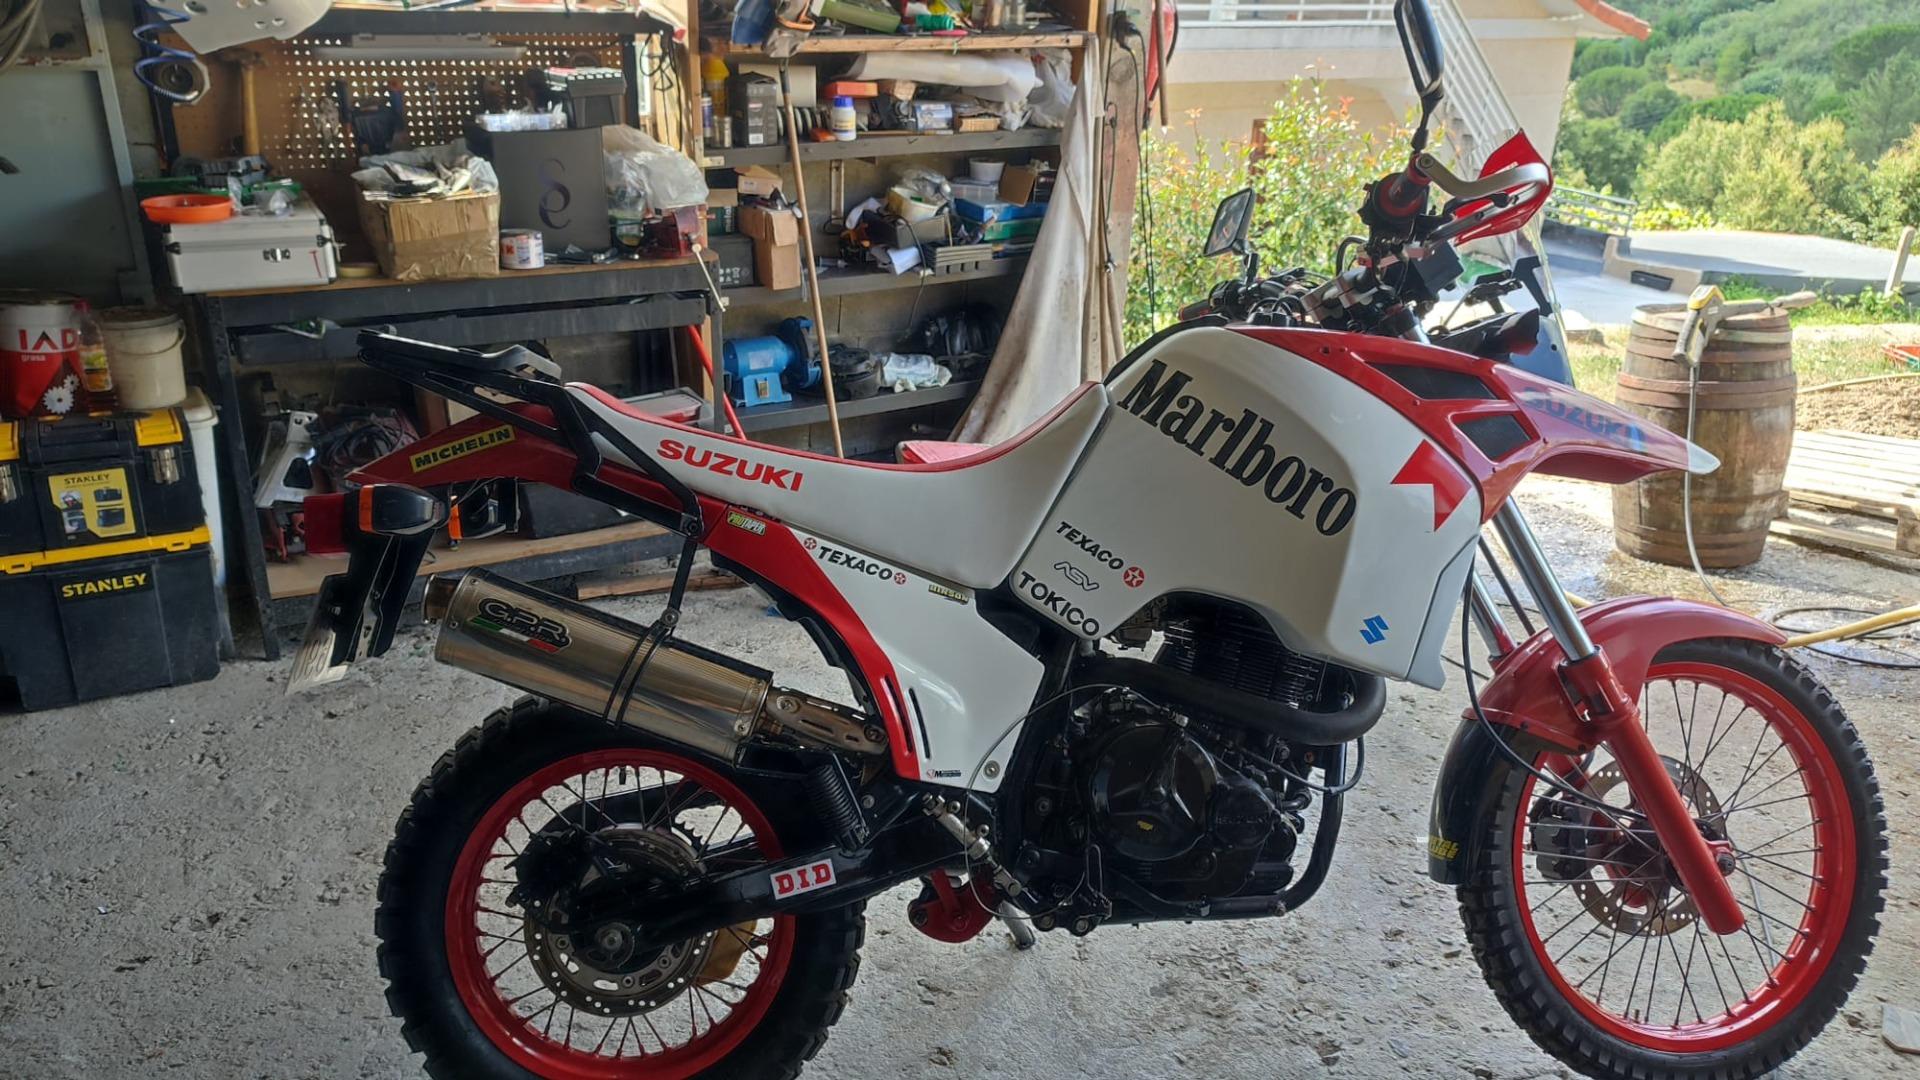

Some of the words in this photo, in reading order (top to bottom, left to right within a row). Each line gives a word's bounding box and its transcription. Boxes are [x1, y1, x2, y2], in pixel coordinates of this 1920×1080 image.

[414, 428, 511, 468] MICHELIN
[656, 439, 804, 492] SUZUKI
[1118, 358, 1358, 537] Marlboro
[64, 473, 110, 486] STANLEY
[817, 546, 893, 581] TEXACO
[1056, 521, 1124, 570] TEXACO
[62, 573, 147, 598] STANLEY
[1019, 570, 1100, 636] TOKICO
